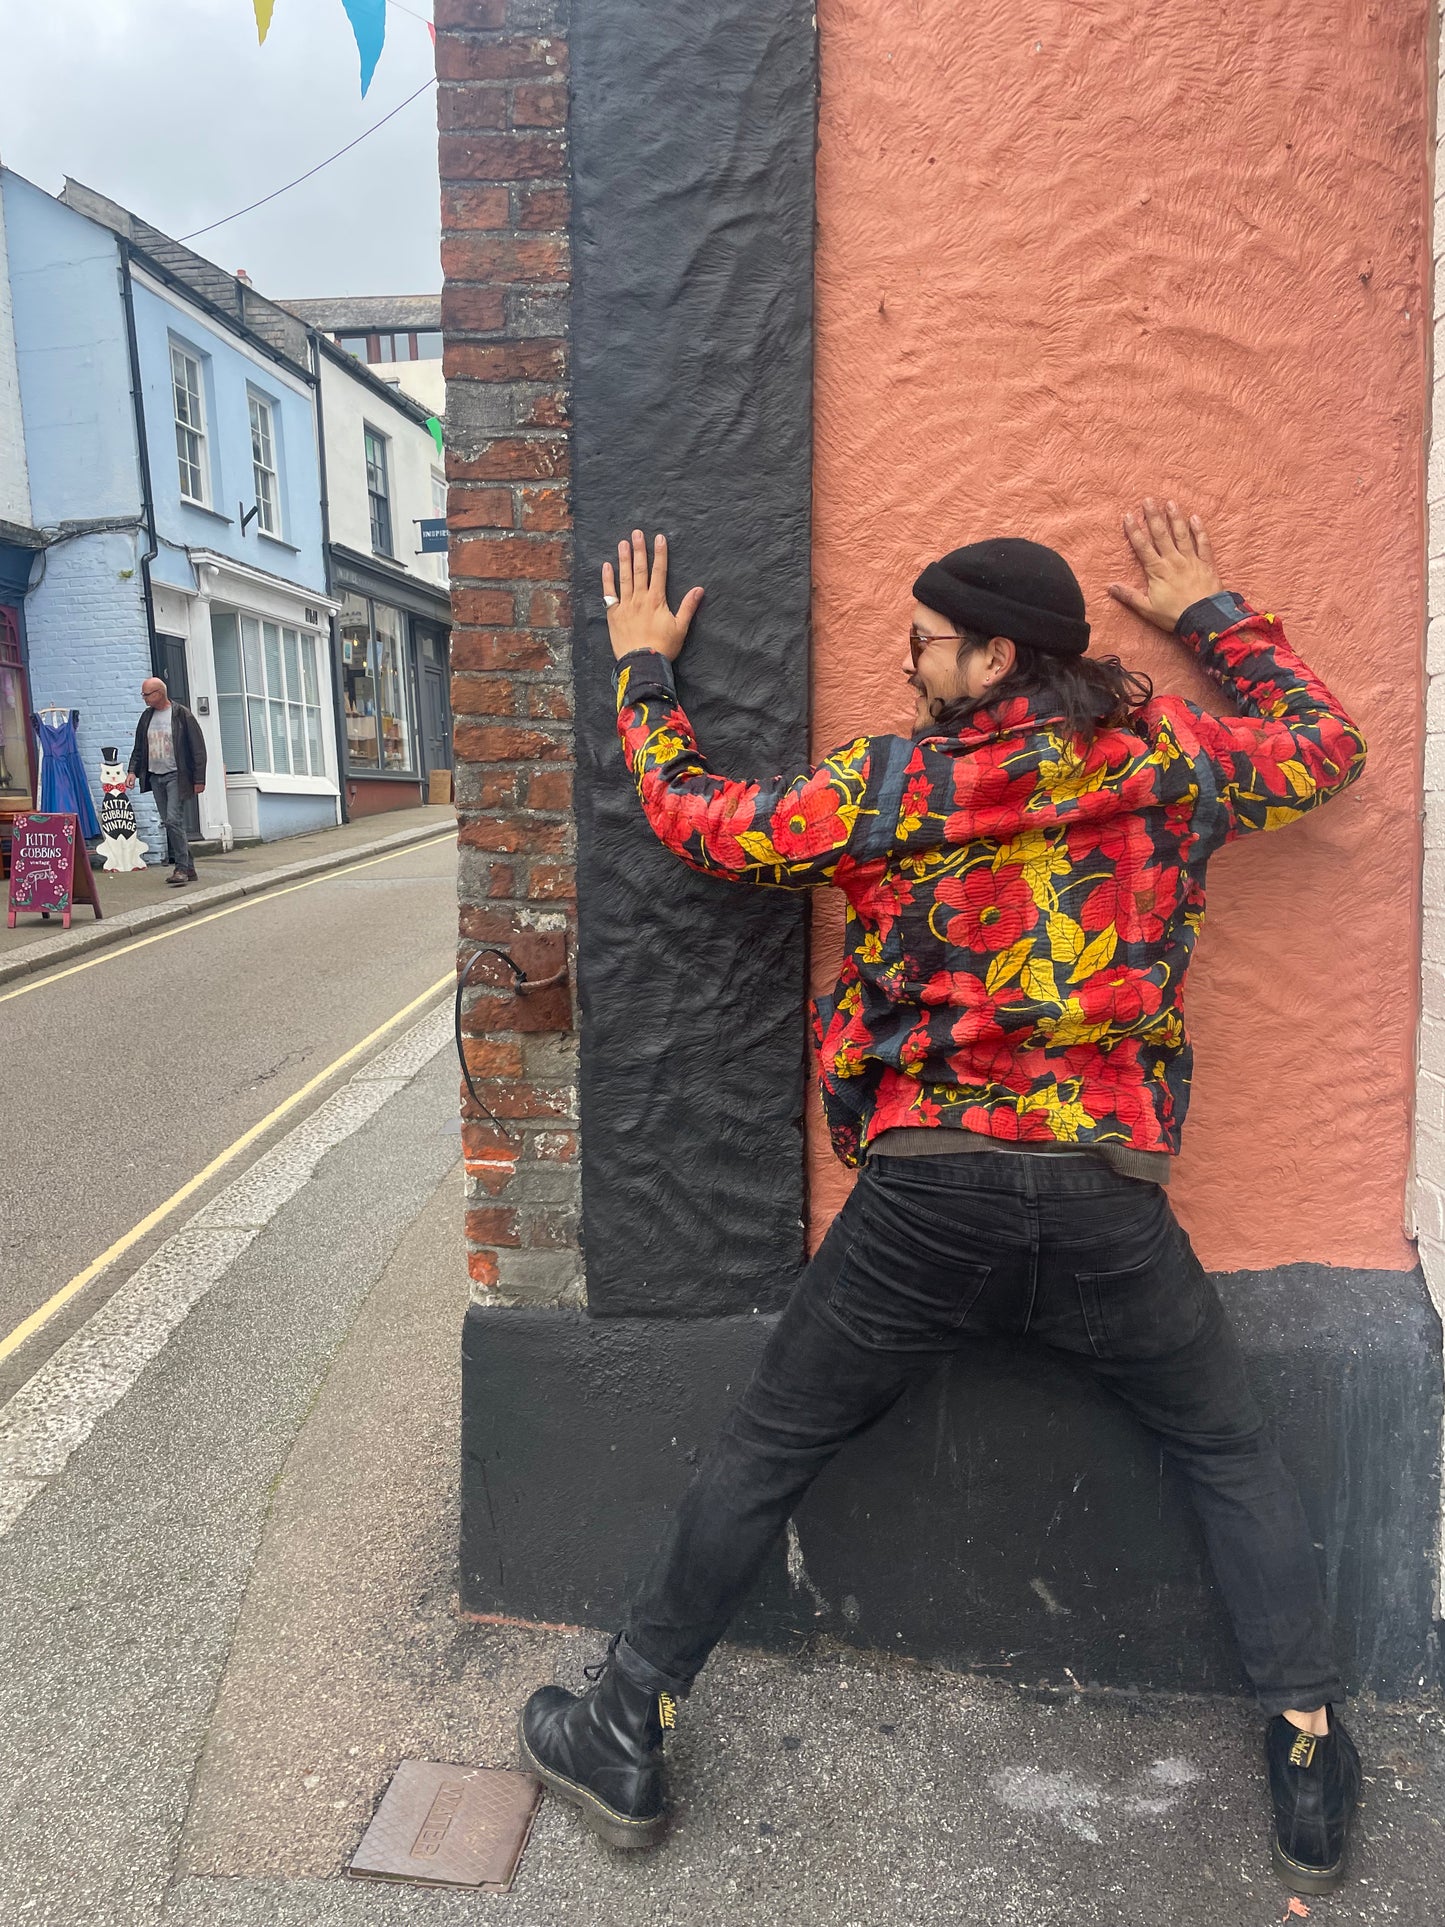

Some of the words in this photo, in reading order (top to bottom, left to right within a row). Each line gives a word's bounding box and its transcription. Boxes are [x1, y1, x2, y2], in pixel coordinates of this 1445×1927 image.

[103, 800, 130, 810] KITTY
[101, 809, 134, 822] GUBBINS
[102, 819, 137, 832] VINTAGE
[25, 833, 58, 846] KITTY
[20, 847, 62, 859] GUBBINS
[415, 1786, 465, 1857] WATER
